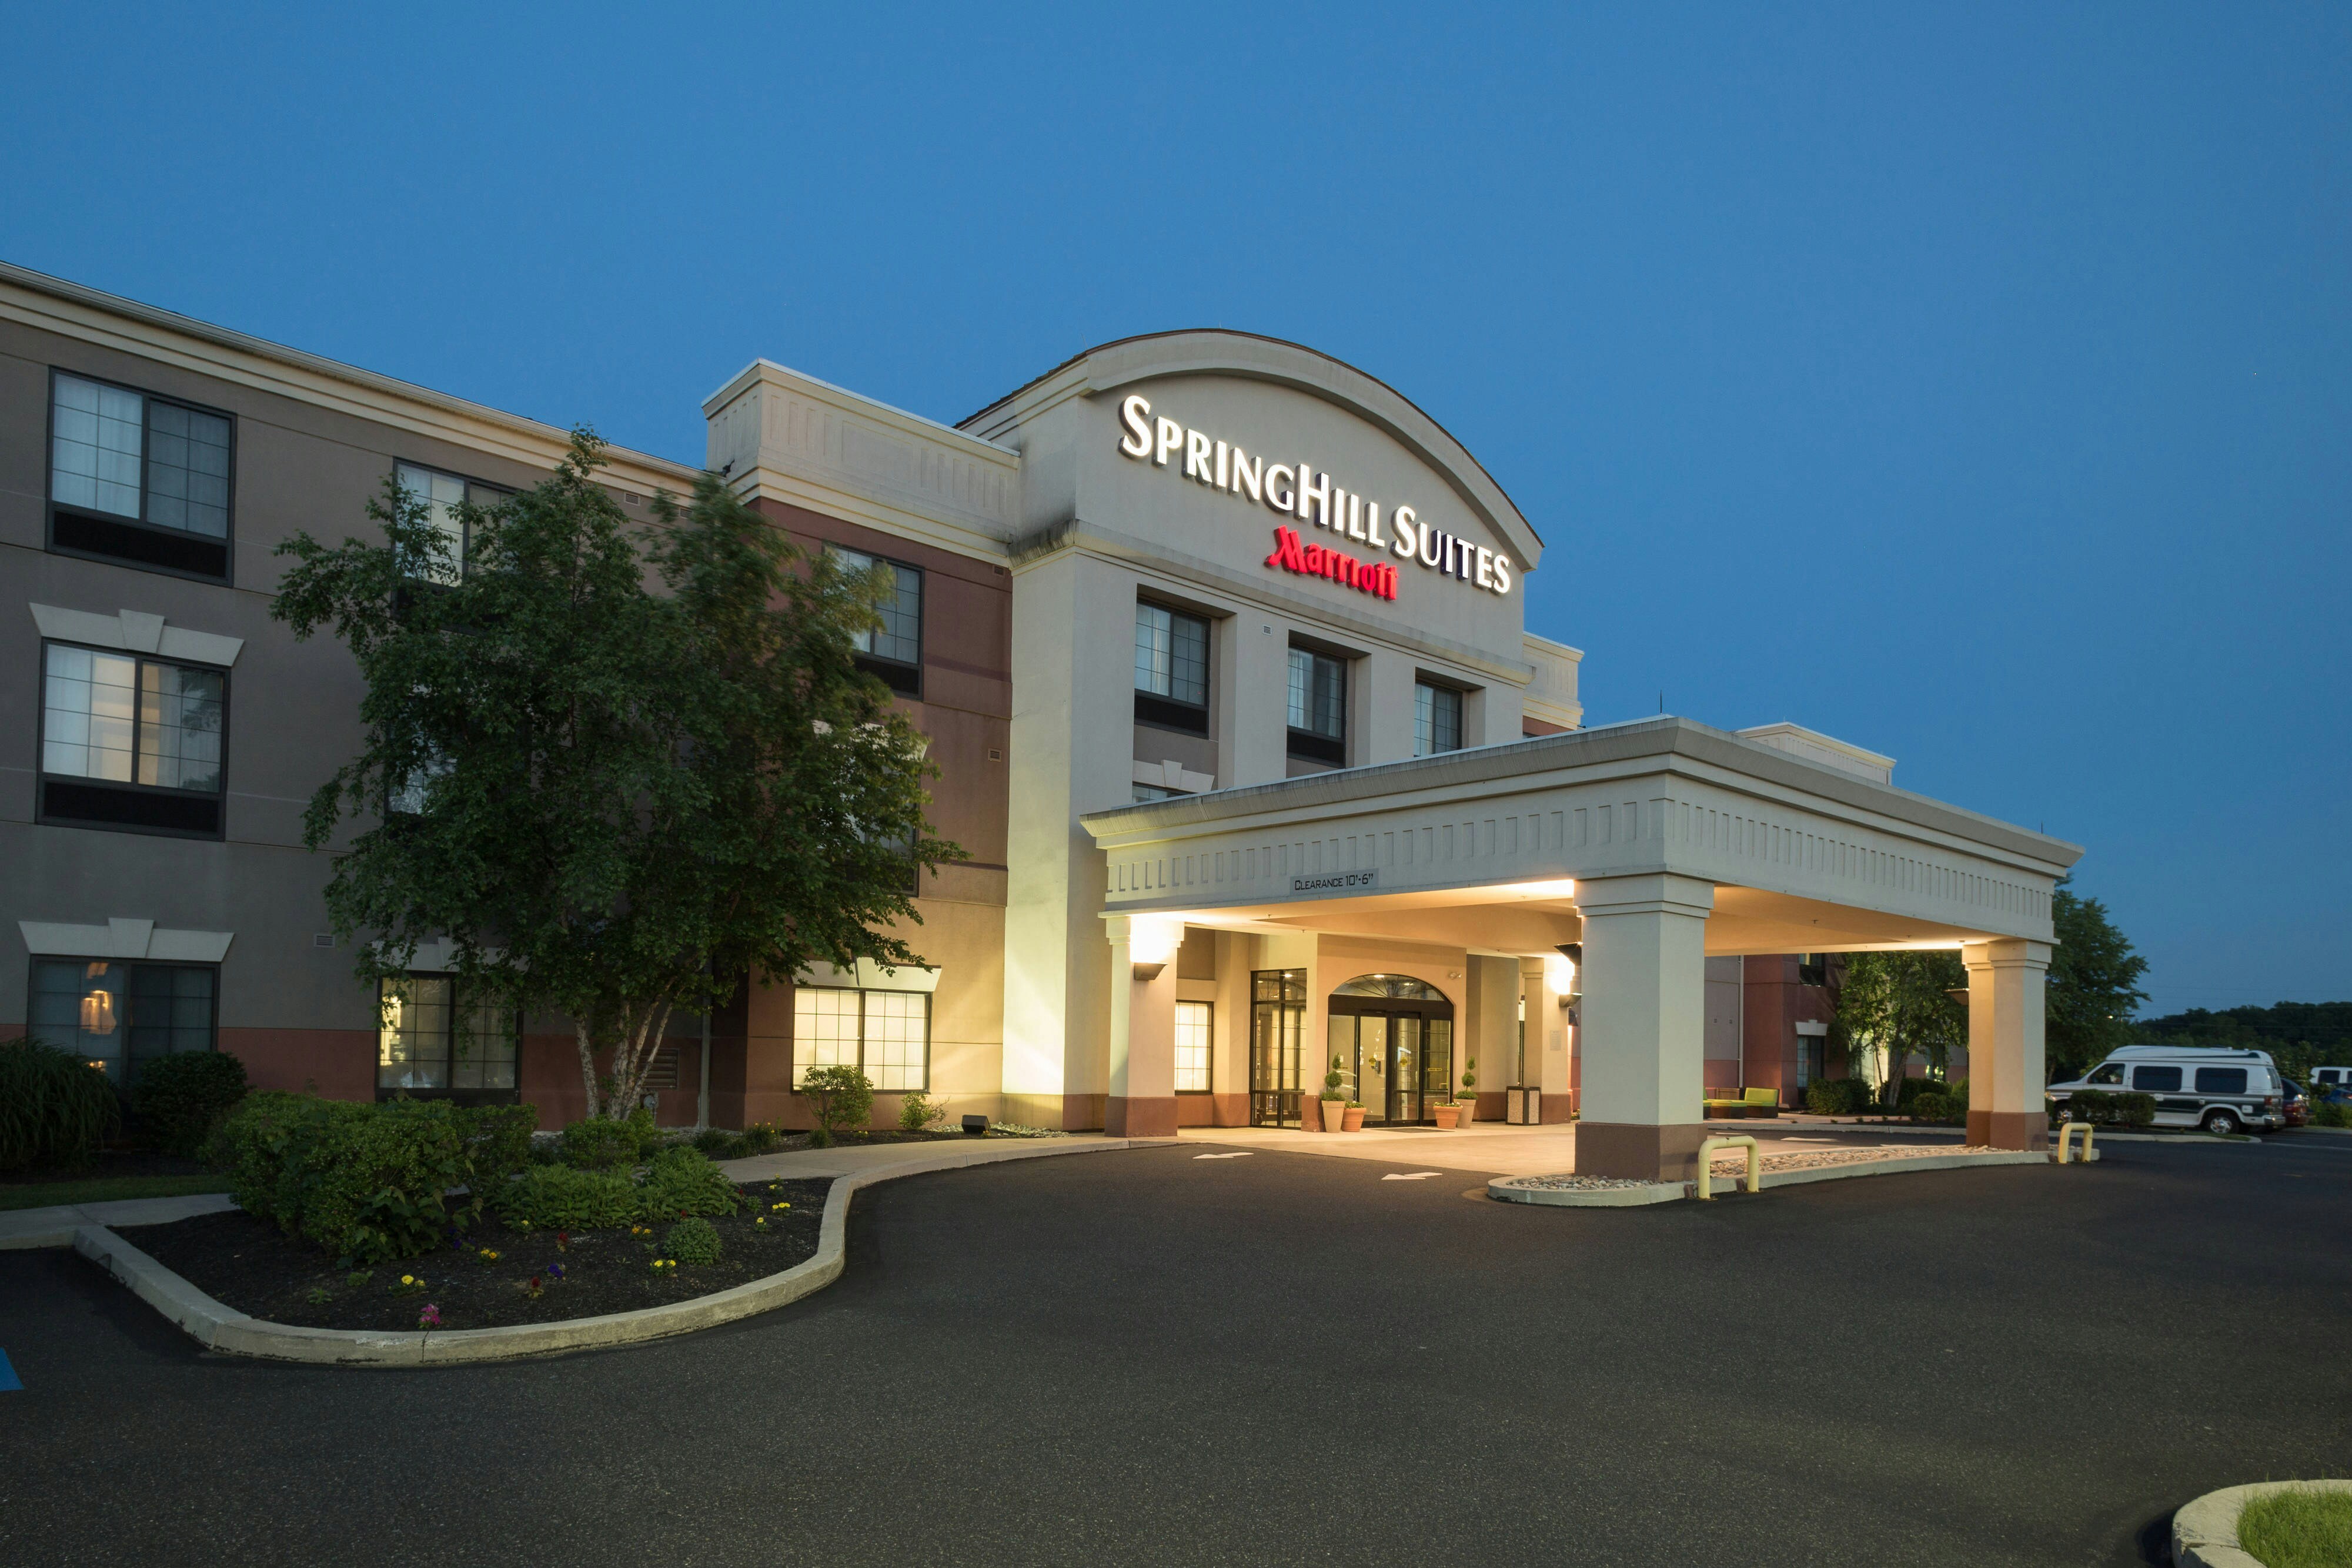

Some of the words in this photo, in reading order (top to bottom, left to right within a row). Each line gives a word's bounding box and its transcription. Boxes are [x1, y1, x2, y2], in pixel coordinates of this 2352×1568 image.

[1119, 394, 1385, 548] SPRINGHILL
[1391, 506, 1510, 594] SUITES
[1265, 525, 1398, 601] Marriott
[1295, 877, 1343, 890] CLEARANCE
